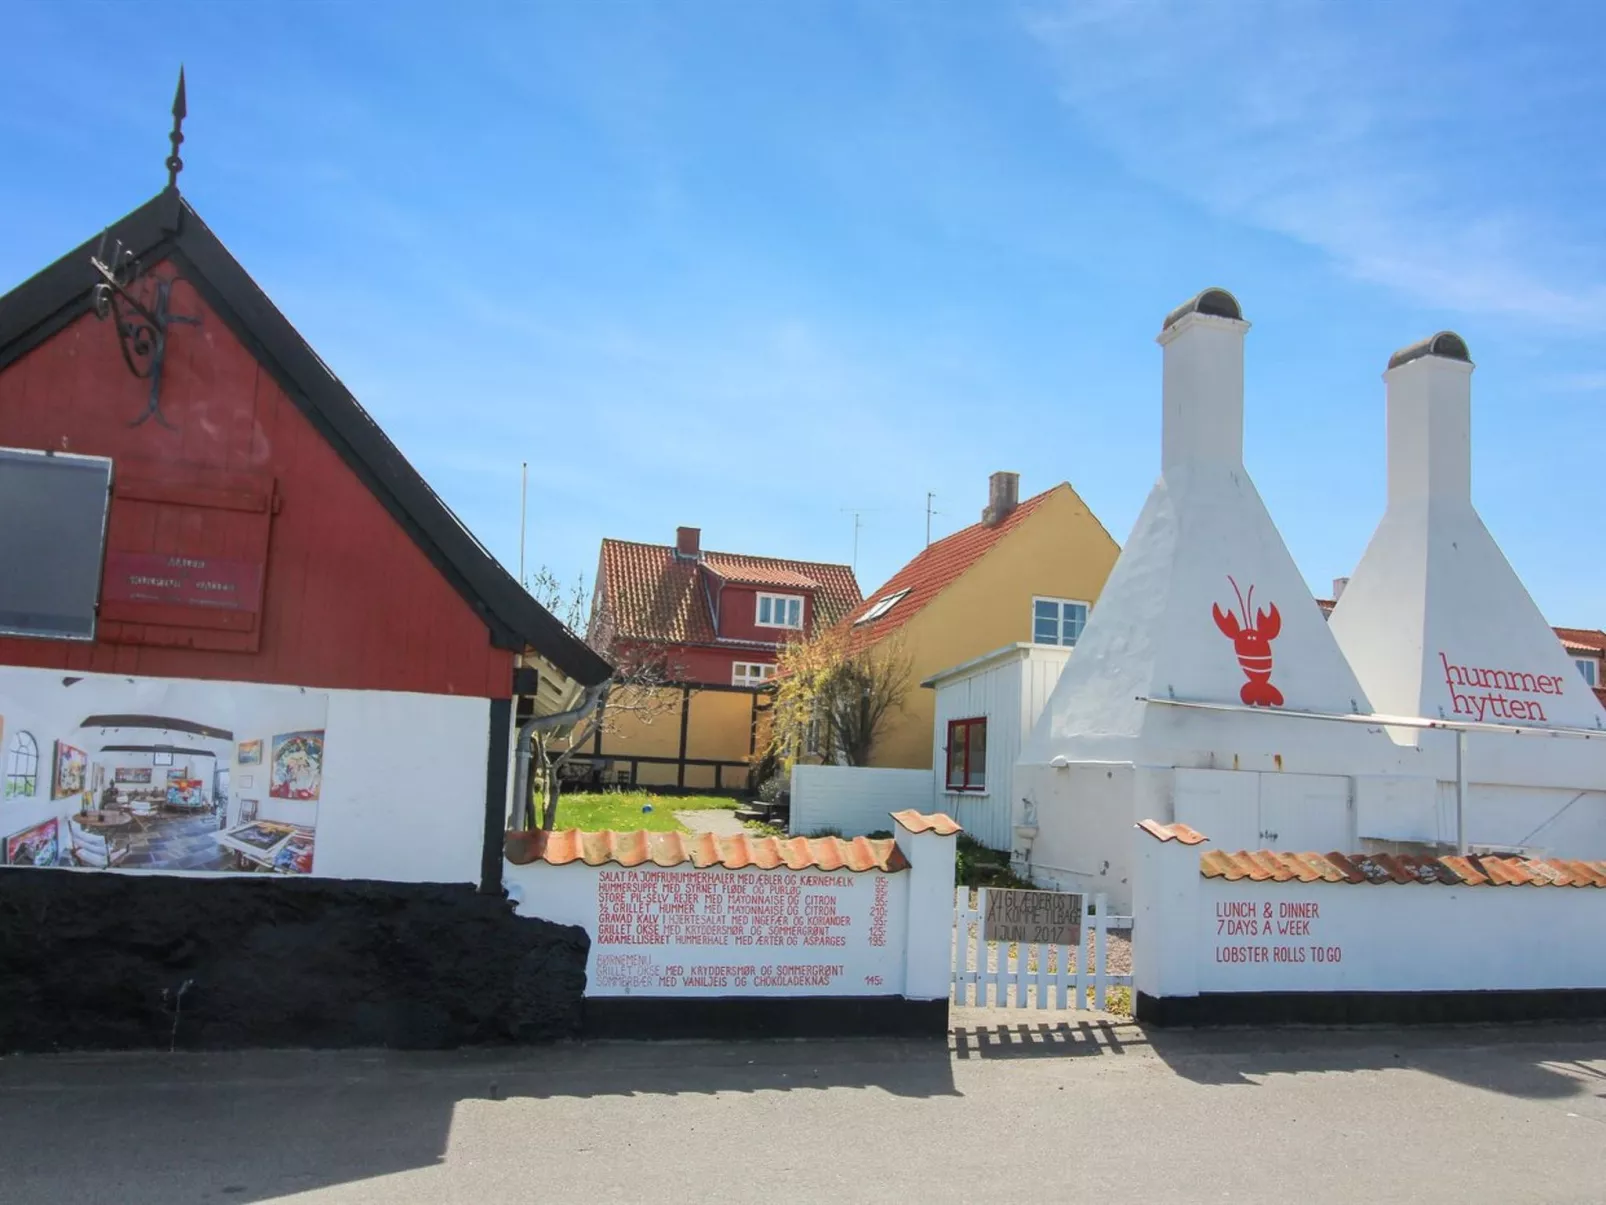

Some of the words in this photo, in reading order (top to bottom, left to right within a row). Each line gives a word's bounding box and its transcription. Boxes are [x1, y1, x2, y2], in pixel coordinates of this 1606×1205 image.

[1439, 652, 1563, 695] hummer
[1449, 683, 1547, 722] hytten
[599, 871, 625, 882] SALAT
[640, 871, 734, 884] JOMFRUHUMMERHALER
[738, 873, 754, 885] MED
[756, 874, 782, 885] ÆBLER
[784, 874, 796, 885] OG
[800, 876, 854, 887] KÆRNEMÆLK
[599, 883, 657, 893] HUMMERSUPPE
[662, 883, 680, 893] MED
[686, 883, 717, 894] SYRNET
[722, 884, 747, 894] FLØDE
[753, 886, 764, 895] OG
[599, 893, 625, 903] STORE
[631, 893, 668, 903] PIL-SELV
[674, 894, 699, 904] REJER
[705, 894, 723, 904] MED
[728, 895, 784, 905] MAYONNAISE
[788, 895, 799, 905] OG
[804, 895, 836, 906] CITRON
[613, 903, 650, 914] GRILLET
[659, 904, 695, 914] HUMMER
[705, 904, 723, 914] MED
[728, 905, 784, 915] MAYONNAISE
[787, 905, 799, 915] OG
[804, 905, 836, 916] CITRON
[1216, 902, 1256, 918] LUNCH
[1262, 902, 1273, 919] &
[1279, 902, 1320, 919] DINNER
[598, 913, 633, 924] GRAVAD
[637, 914, 659, 924] KALV
[669, 914, 726, 925] HJERTESALAT
[732, 915, 748, 925] MED
[752, 916, 788, 926] INGEFÆR
[793, 916, 804, 926] OG
[807, 916, 851, 926] KORIANDER
[598, 924, 631, 935] GRILLET
[636, 924, 659, 935] OKSE
[663, 925, 681, 935] MED
[750, 926, 762, 936] OG
[768, 926, 830, 936] SOMMERGRØNT
[1000, 925, 1026, 940] JUNI
[1034, 926, 1064, 942] 2017
[1217, 920, 1224, 935] 7
[1227, 920, 1258, 936] DAYS
[1262, 920, 1273, 935] A
[1277, 920, 1310, 936] WEEK
[597, 934, 671, 945] KARAMELLISERET
[675, 935, 728, 945] HUMMERHALE
[735, 935, 753, 946] MED
[755, 936, 784, 946] ÆRTER
[786, 936, 798, 946] OG
[803, 936, 846, 947] ASPARGES
[1216, 946, 1269, 963] LOBSTER
[1273, 946, 1305, 962] ROLLS
[1310, 946, 1324, 962] TO
[1327, 946, 1342, 962] GO
[596, 965, 632, 976] GRILLET
[637, 966, 660, 976] OKSE
[665, 966, 684, 976] MED
[691, 966, 755, 976] KRYDDERSMØR
[761, 965, 772, 976] OG
[776, 965, 844, 976] SOMMERGRØNT
[659, 976, 677, 987] MED
[683, 976, 727, 987] VANILJEIS
[735, 976, 747, 987] OG
[754, 976, 830, 987] CHOKOLADEKNAS
